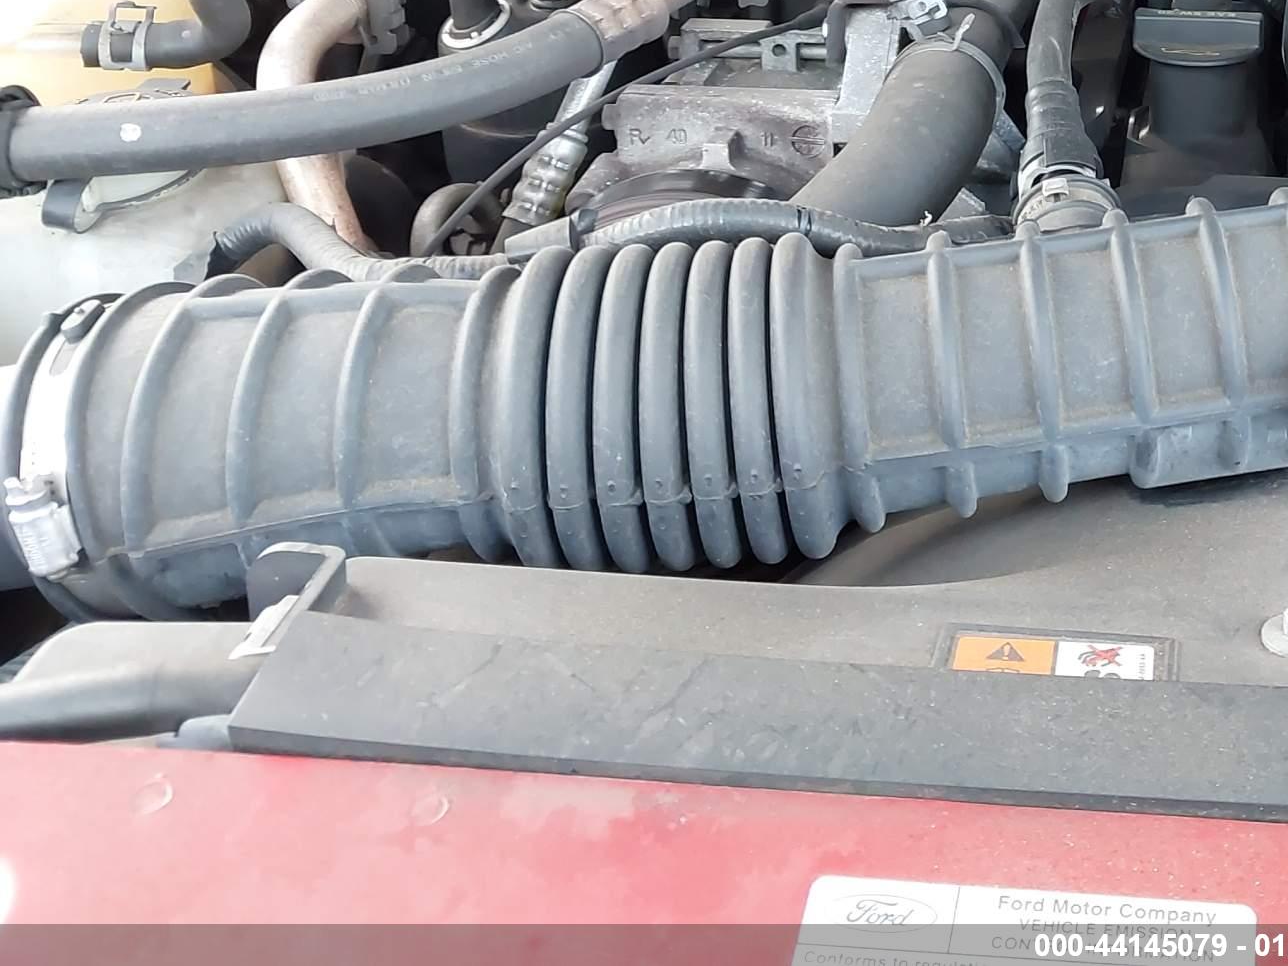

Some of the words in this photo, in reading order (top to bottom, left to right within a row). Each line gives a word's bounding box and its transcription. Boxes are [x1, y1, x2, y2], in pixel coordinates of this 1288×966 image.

[846, 899, 915, 927] Ford
[998, 895, 1045, 912] Ford
[1053, 899, 1112, 918] Motor
[1119, 903, 1217, 927] Company
[1019, 918, 1095, 936] VEHICLE
